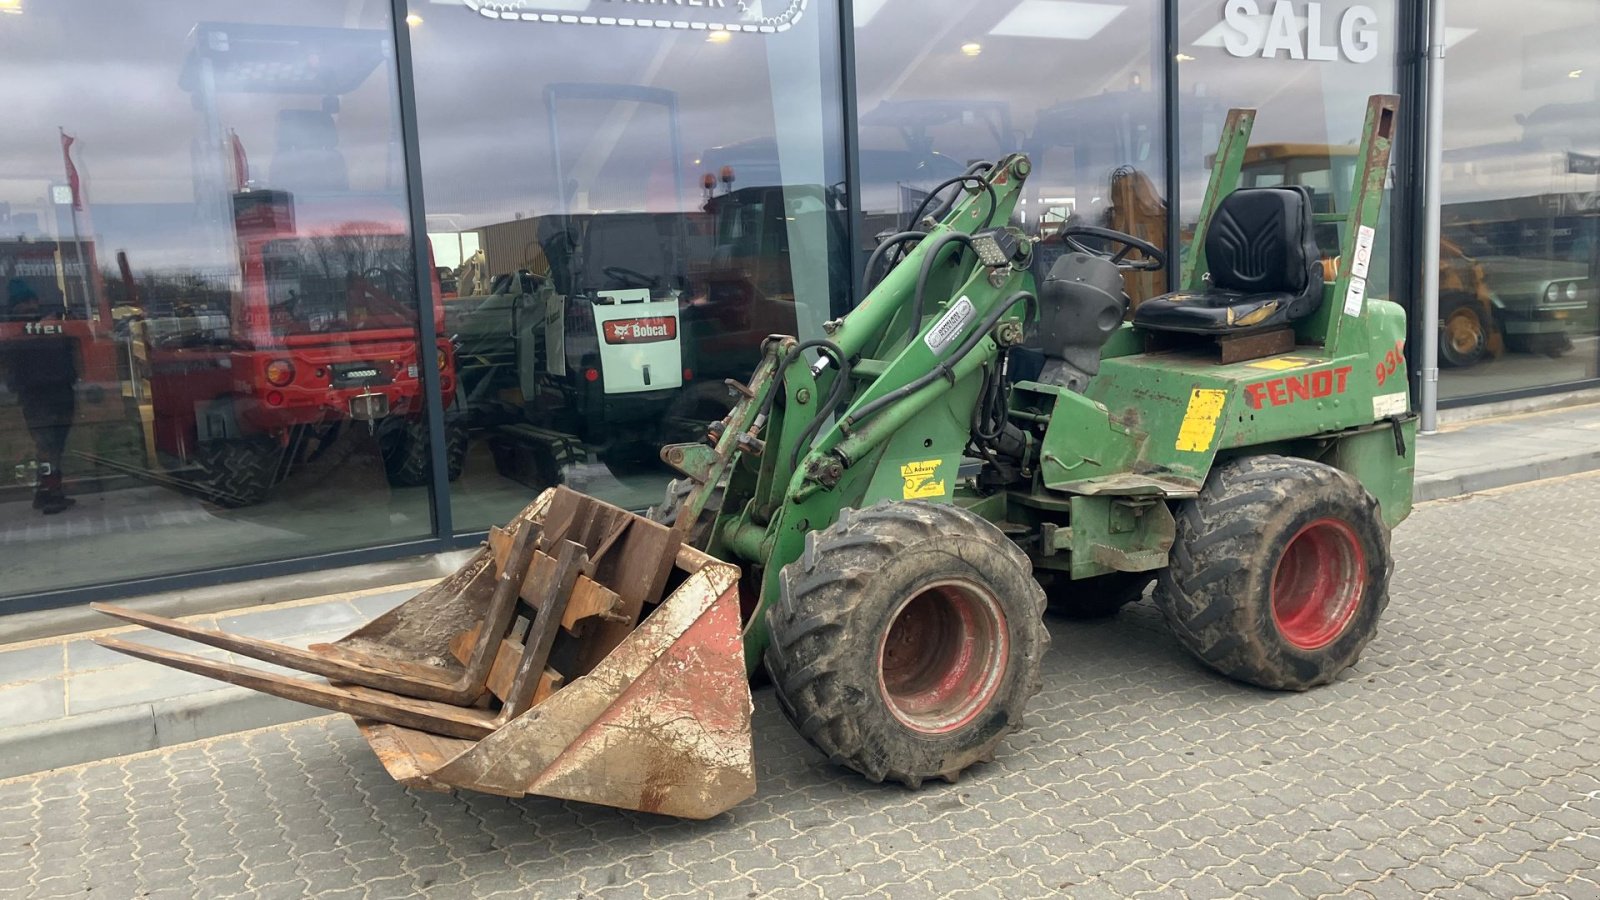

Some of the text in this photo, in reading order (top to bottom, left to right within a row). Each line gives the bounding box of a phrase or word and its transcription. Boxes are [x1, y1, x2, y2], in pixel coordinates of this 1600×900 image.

[1223, 0, 1379, 63] SALG
[632, 323, 668, 337] Bobcat
[1246, 366, 1353, 410] FENDT
